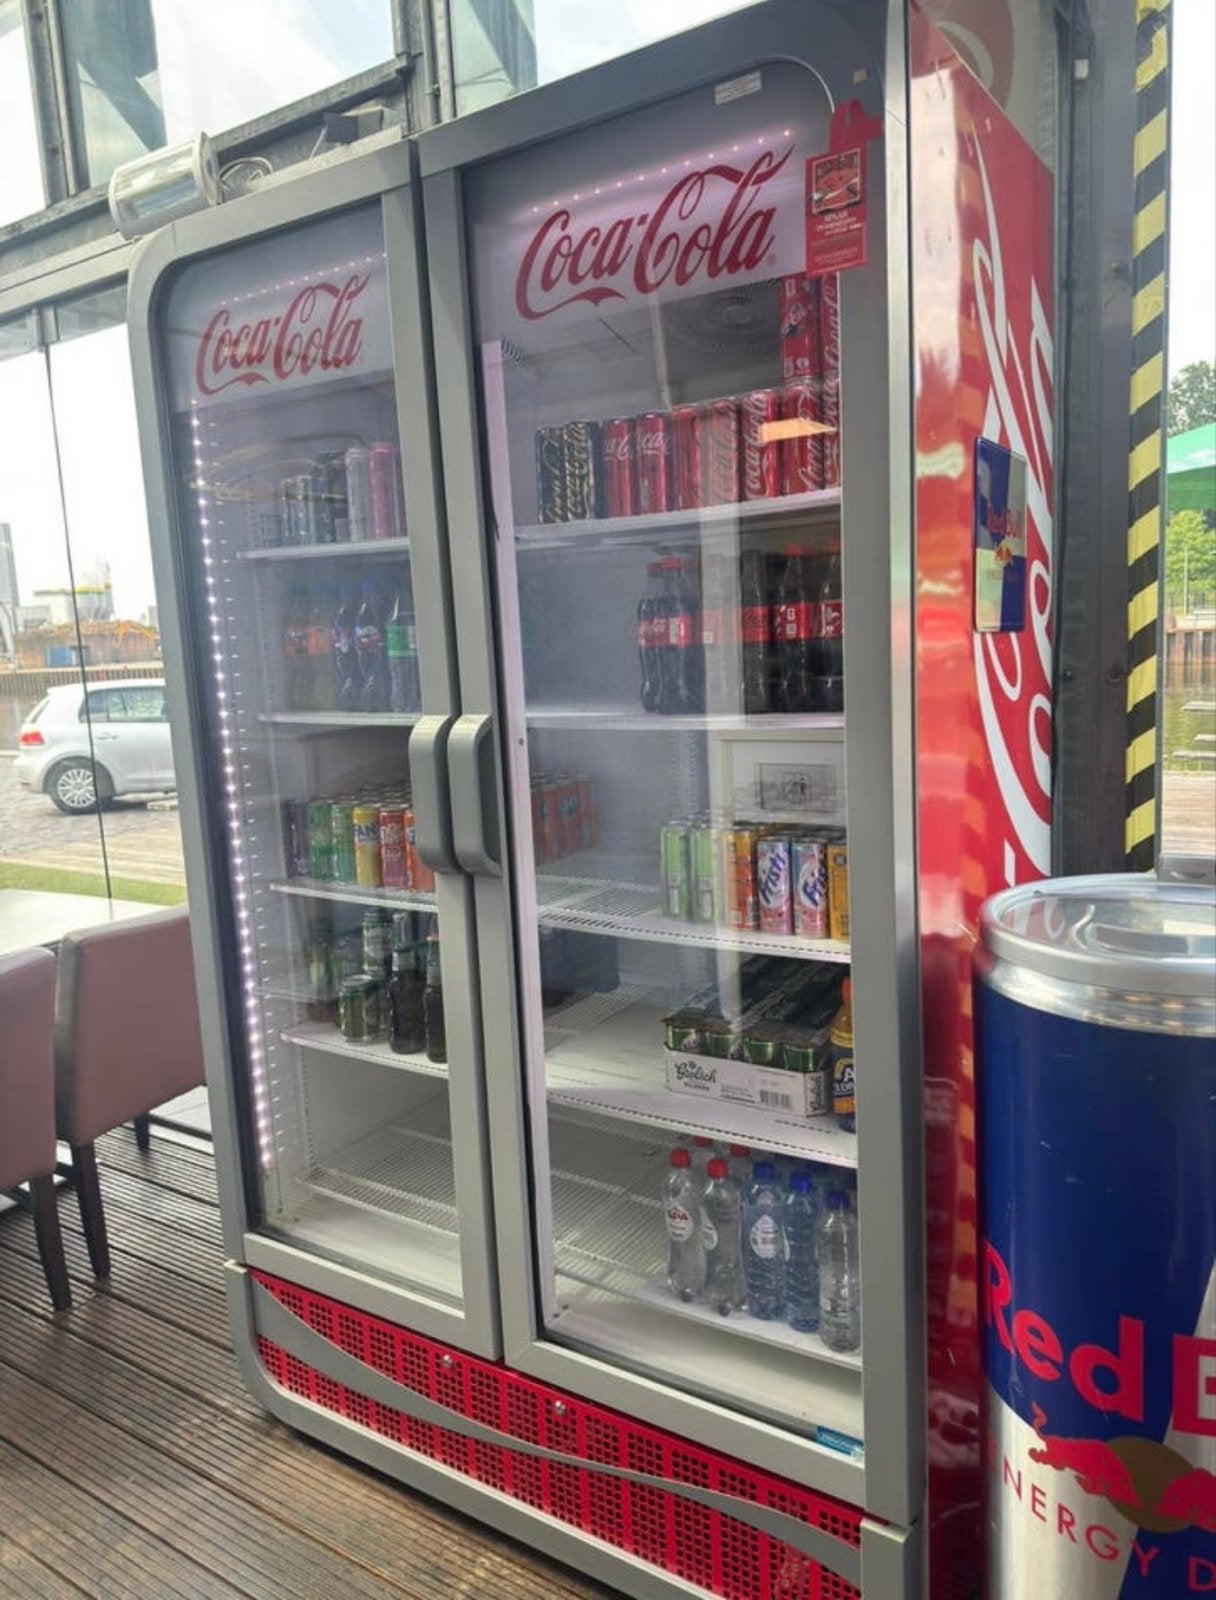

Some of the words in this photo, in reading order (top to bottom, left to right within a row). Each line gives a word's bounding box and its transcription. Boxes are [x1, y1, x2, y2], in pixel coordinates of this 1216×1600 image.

[515, 144, 795, 321] Coca-Cola
[195, 272, 371, 397] Coca-Cola
[353, 822, 380, 841] FAN
[983, 1237, 1145, 1423] Red
